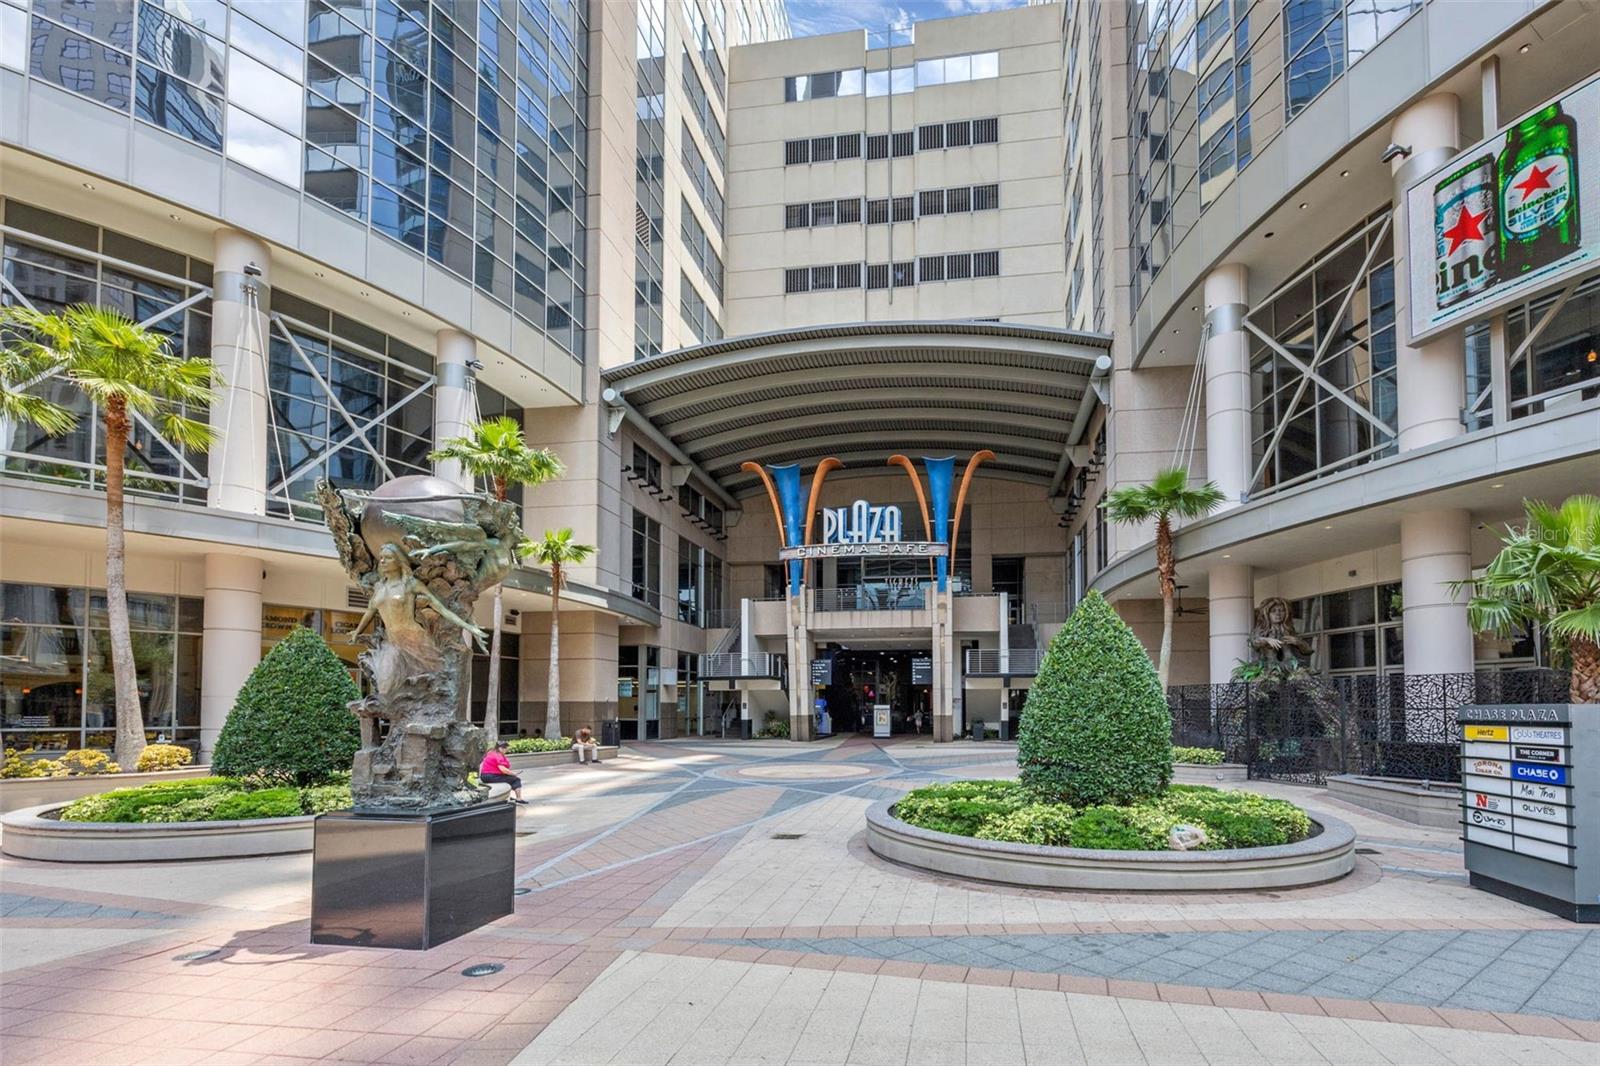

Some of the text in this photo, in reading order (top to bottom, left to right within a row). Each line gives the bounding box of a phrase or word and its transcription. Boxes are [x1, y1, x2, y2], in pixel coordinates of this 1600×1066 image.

[1508, 193, 1567, 227] SILVER
[823, 500, 901, 545] PLAZA
[797, 544, 929, 557] CINEMA CAFE
[1466, 708, 1559, 721] CHASE PLAZA
[1533, 730, 1562, 740] THEATRES
[1517, 767, 1548, 778] CHASE
[1521, 784, 1556, 799] Mai Thai
[1522, 804, 1556, 816] OLIVES
